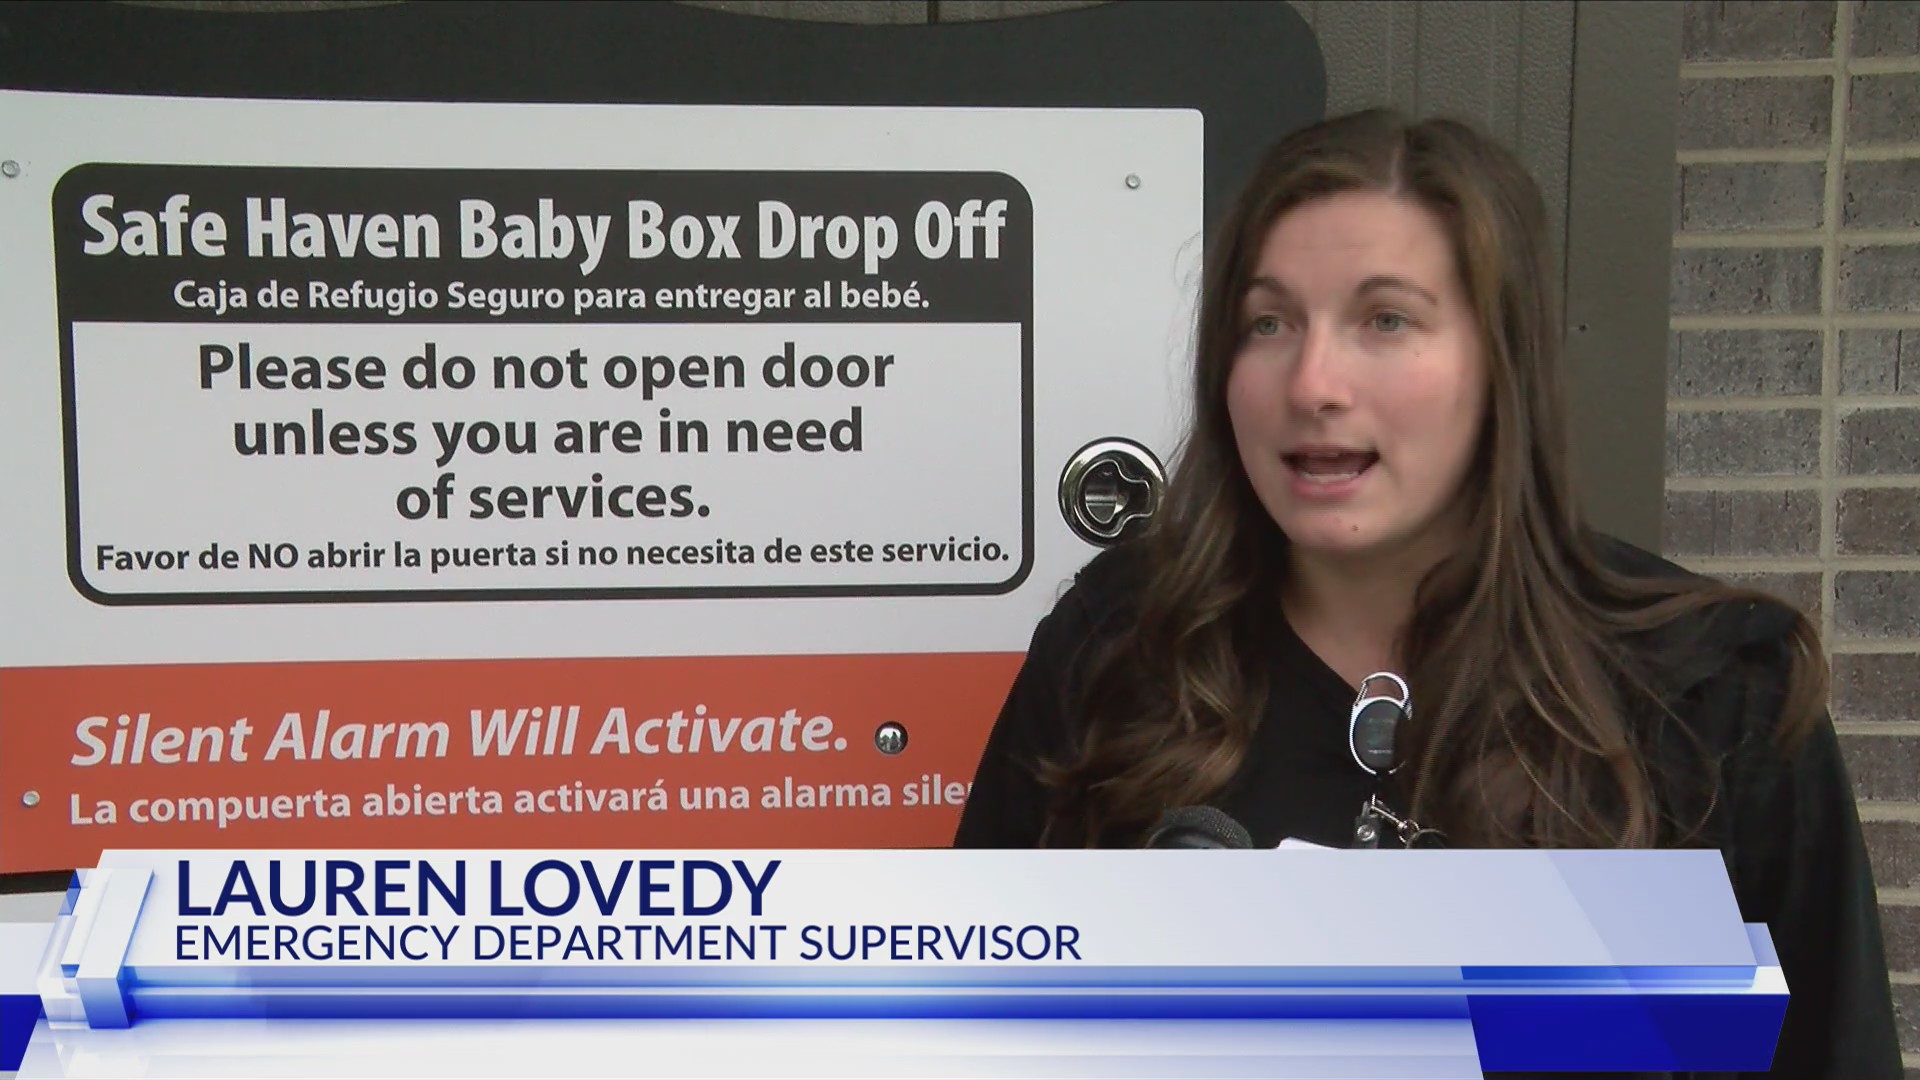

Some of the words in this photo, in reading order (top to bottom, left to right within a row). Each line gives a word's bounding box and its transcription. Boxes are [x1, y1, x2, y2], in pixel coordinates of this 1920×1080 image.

[83, 194, 226, 256] Safe
[247, 198, 439, 258] Haven
[460, 199, 611, 275] Baby
[629, 200, 741, 258] Box
[759, 201, 898, 274] Drop
[915, 200, 1007, 259] Off
[174, 280, 247, 315] Caja
[258, 280, 299, 307] de
[309, 280, 438, 315] Refugio
[448, 282, 564, 315] Seguro
[575, 289, 645, 315] para
[656, 285, 795, 315] entregar
[804, 281, 830, 307] al
[842, 281, 929, 307] bebé.
[200, 343, 386, 389] Please
[403, 343, 475, 389] do
[494, 349, 587, 389] not
[604, 356, 744, 400] open
[763, 342, 894, 388] door
[235, 409, 417, 455] unless
[432, 421, 536, 468] you
[554, 421, 642, 453] are
[660, 408, 708, 452] in
[728, 406, 862, 452] need
[397, 473, 455, 519] of
[470, 473, 709, 519] services.
[97, 545, 189, 570] Favor
[199, 543, 239, 569] de
[249, 543, 298, 568] NO
[308, 542, 385, 568] abrir
[395, 541, 420, 567] la
[432, 544, 535, 573] puerta
[546, 540, 568, 565] si
[579, 547, 617, 565] no
[628, 539, 754, 564] necesita
[764, 538, 801, 563] de
[811, 540, 873, 562] este
[883, 536, 1008, 562] servicio.
[71, 714, 253, 765] Silent
[264, 710, 449, 760] Alarm
[471, 706, 580, 756] Will
[590, 704, 847, 754] Activate.
[71, 794, 116, 824] La
[130, 790, 350, 828] compuerta
[363, 784, 502, 816] abierta
[515, 779, 667, 813] activará
[680, 787, 749, 810] una
[761, 777, 890, 808] alarma
